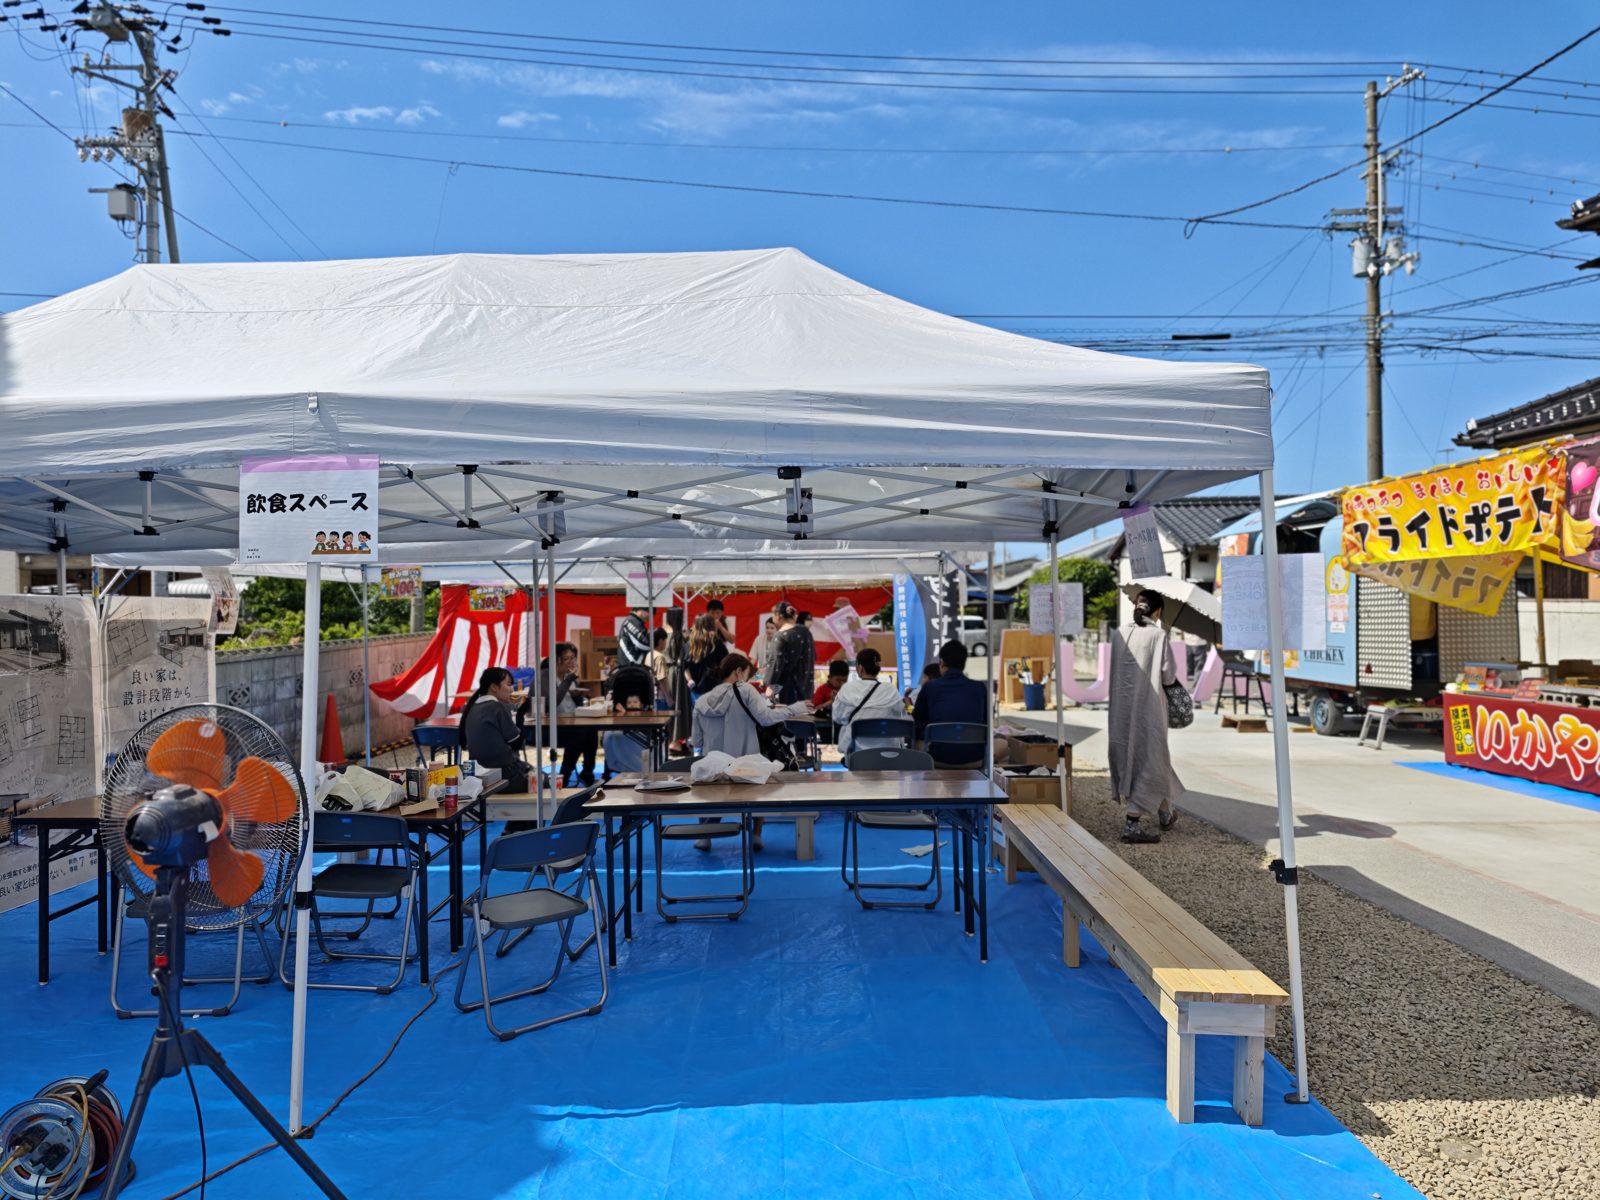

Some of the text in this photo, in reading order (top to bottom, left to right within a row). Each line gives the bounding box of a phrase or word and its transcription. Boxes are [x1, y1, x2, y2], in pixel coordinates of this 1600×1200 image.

[1412, 476, 1467, 500] ほくほく
[1477, 463, 1540, 490] おいしい
[246, 492, 369, 514] 飲食スペース
[1304, 648, 1344, 663] CHICKEN
[131, 668, 182, 685] 良い家は、
[123, 686, 192, 707] 設計段階から
[1475, 704, 1600, 782] いかや
